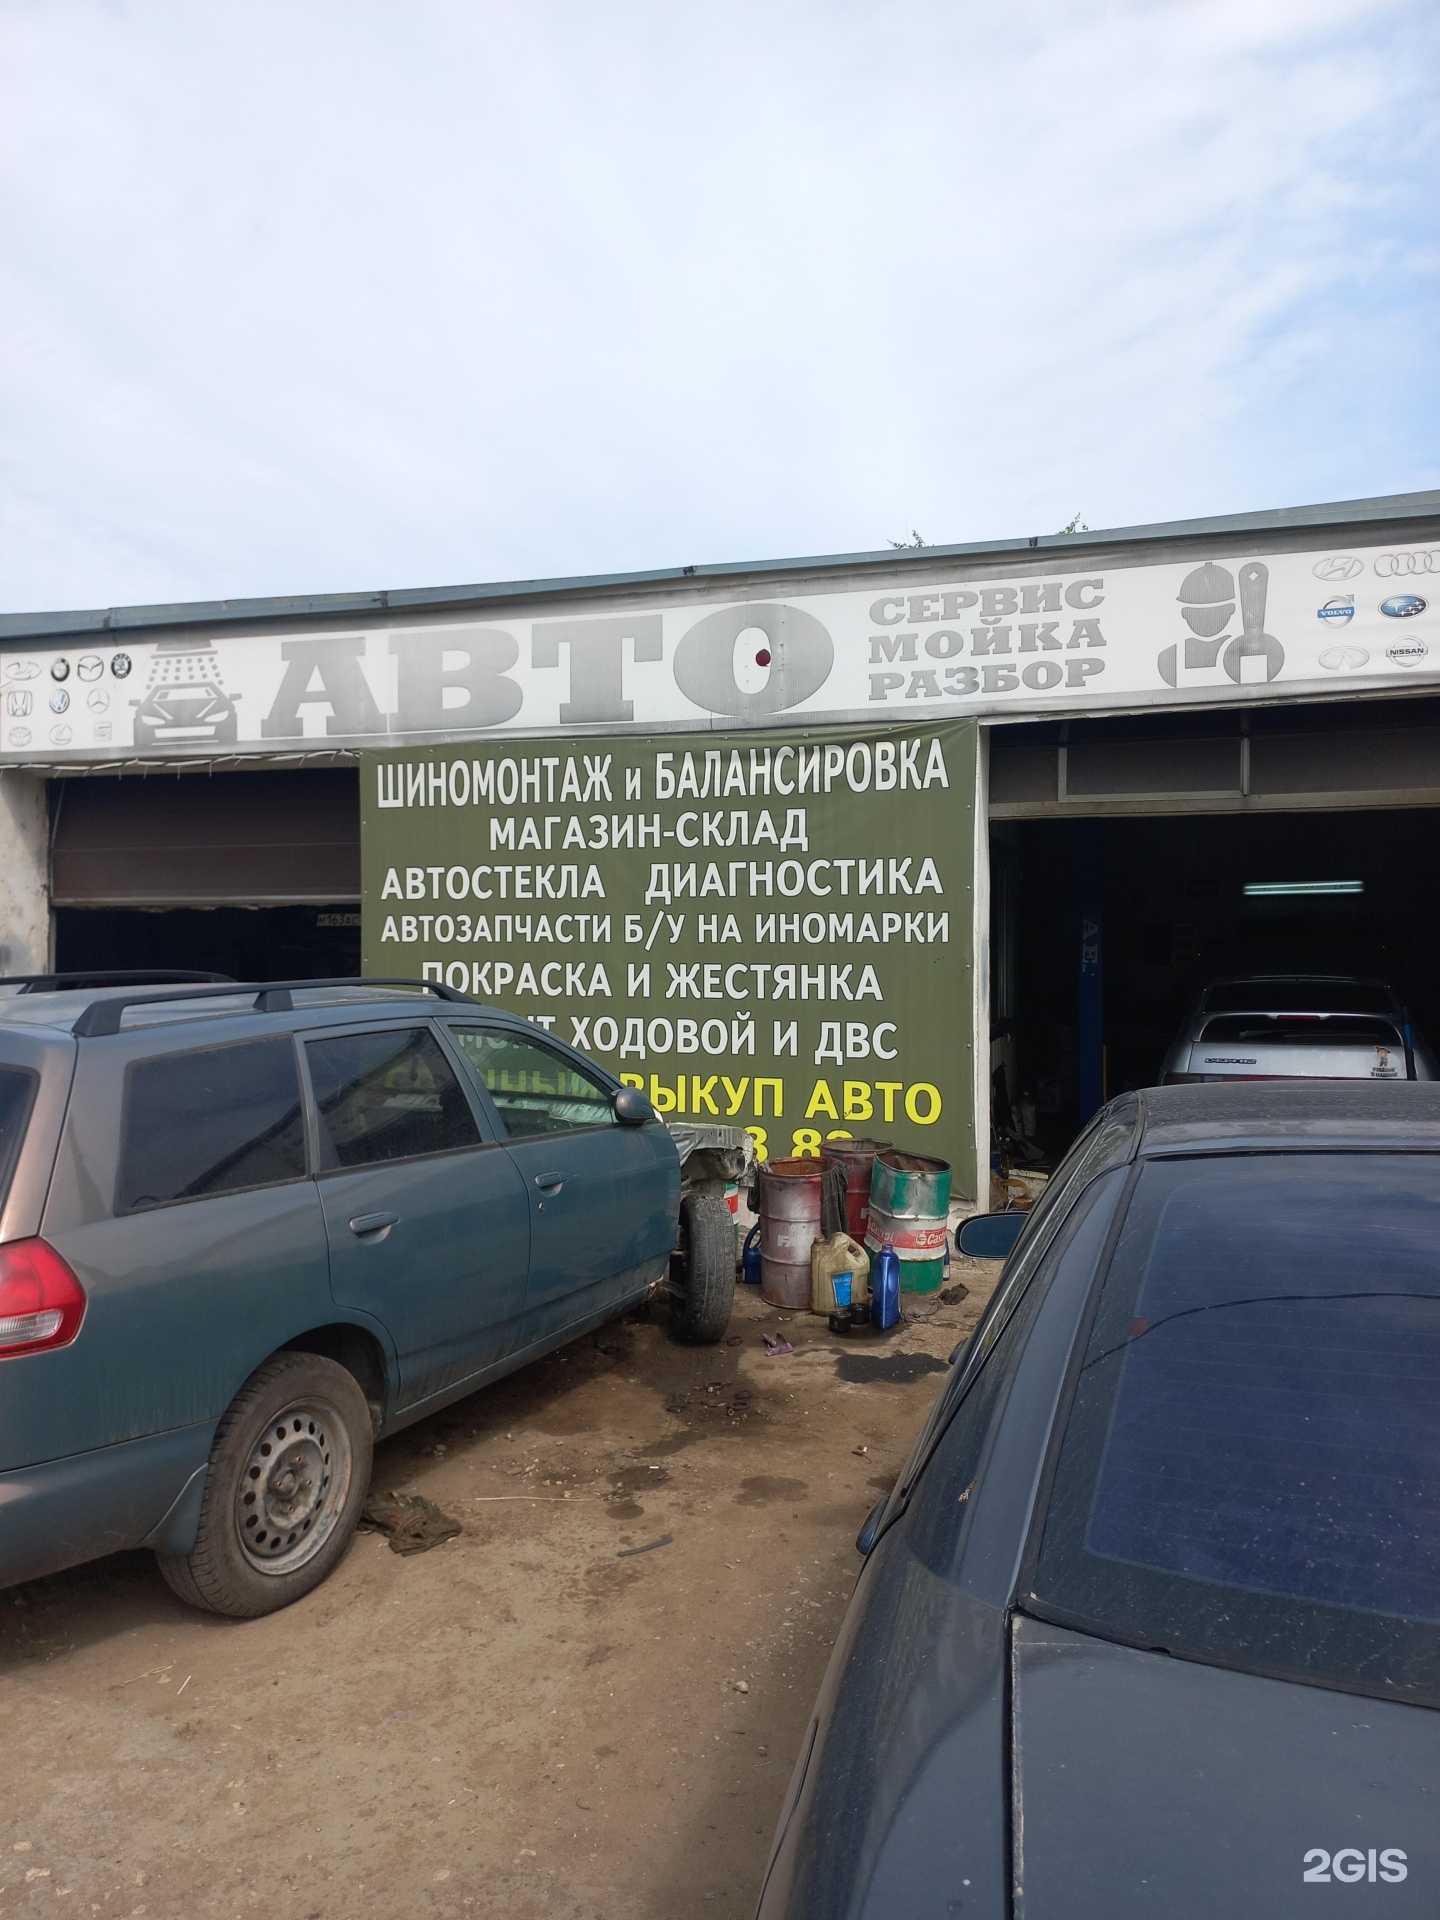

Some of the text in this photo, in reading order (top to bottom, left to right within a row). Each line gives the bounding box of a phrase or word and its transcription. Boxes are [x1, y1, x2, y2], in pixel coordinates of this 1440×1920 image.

[869, 578, 1105, 626] СЕРВИС
[868, 617, 1107, 663] МОЙКА
[1389, 648, 1424, 656] NISSAN
[260, 603, 835, 739] АВТО
[868, 657, 1106, 701] РАЗБОР
[377, 754, 613, 808] ШИНОМОНТАЖ
[655, 738, 949, 800] БАЛАНСИРОВКА
[489, 808, 808, 853] МАГАЗИН-СКЛАД
[380, 857, 944, 906] АВТОСТЕКЛА ДИАГНОСТИКА
[380, 914, 611, 944] АВТОЗАПЧАСТИ
[624, 911, 686, 951] Б/У
[698, 914, 743, 943] НА
[755, 911, 950, 944] ИНОМАРКИ
[422, 961, 884, 1002] ПОКРАСКА И ЖЕСТЯНКА
[570, 1011, 755, 1060] ХОДОВОЙ
[773, 1020, 798, 1057] И
[814, 1021, 898, 1066] ДВС
[804, 1079, 943, 1125] АВТО
[791, 1128, 854, 1158] 8
